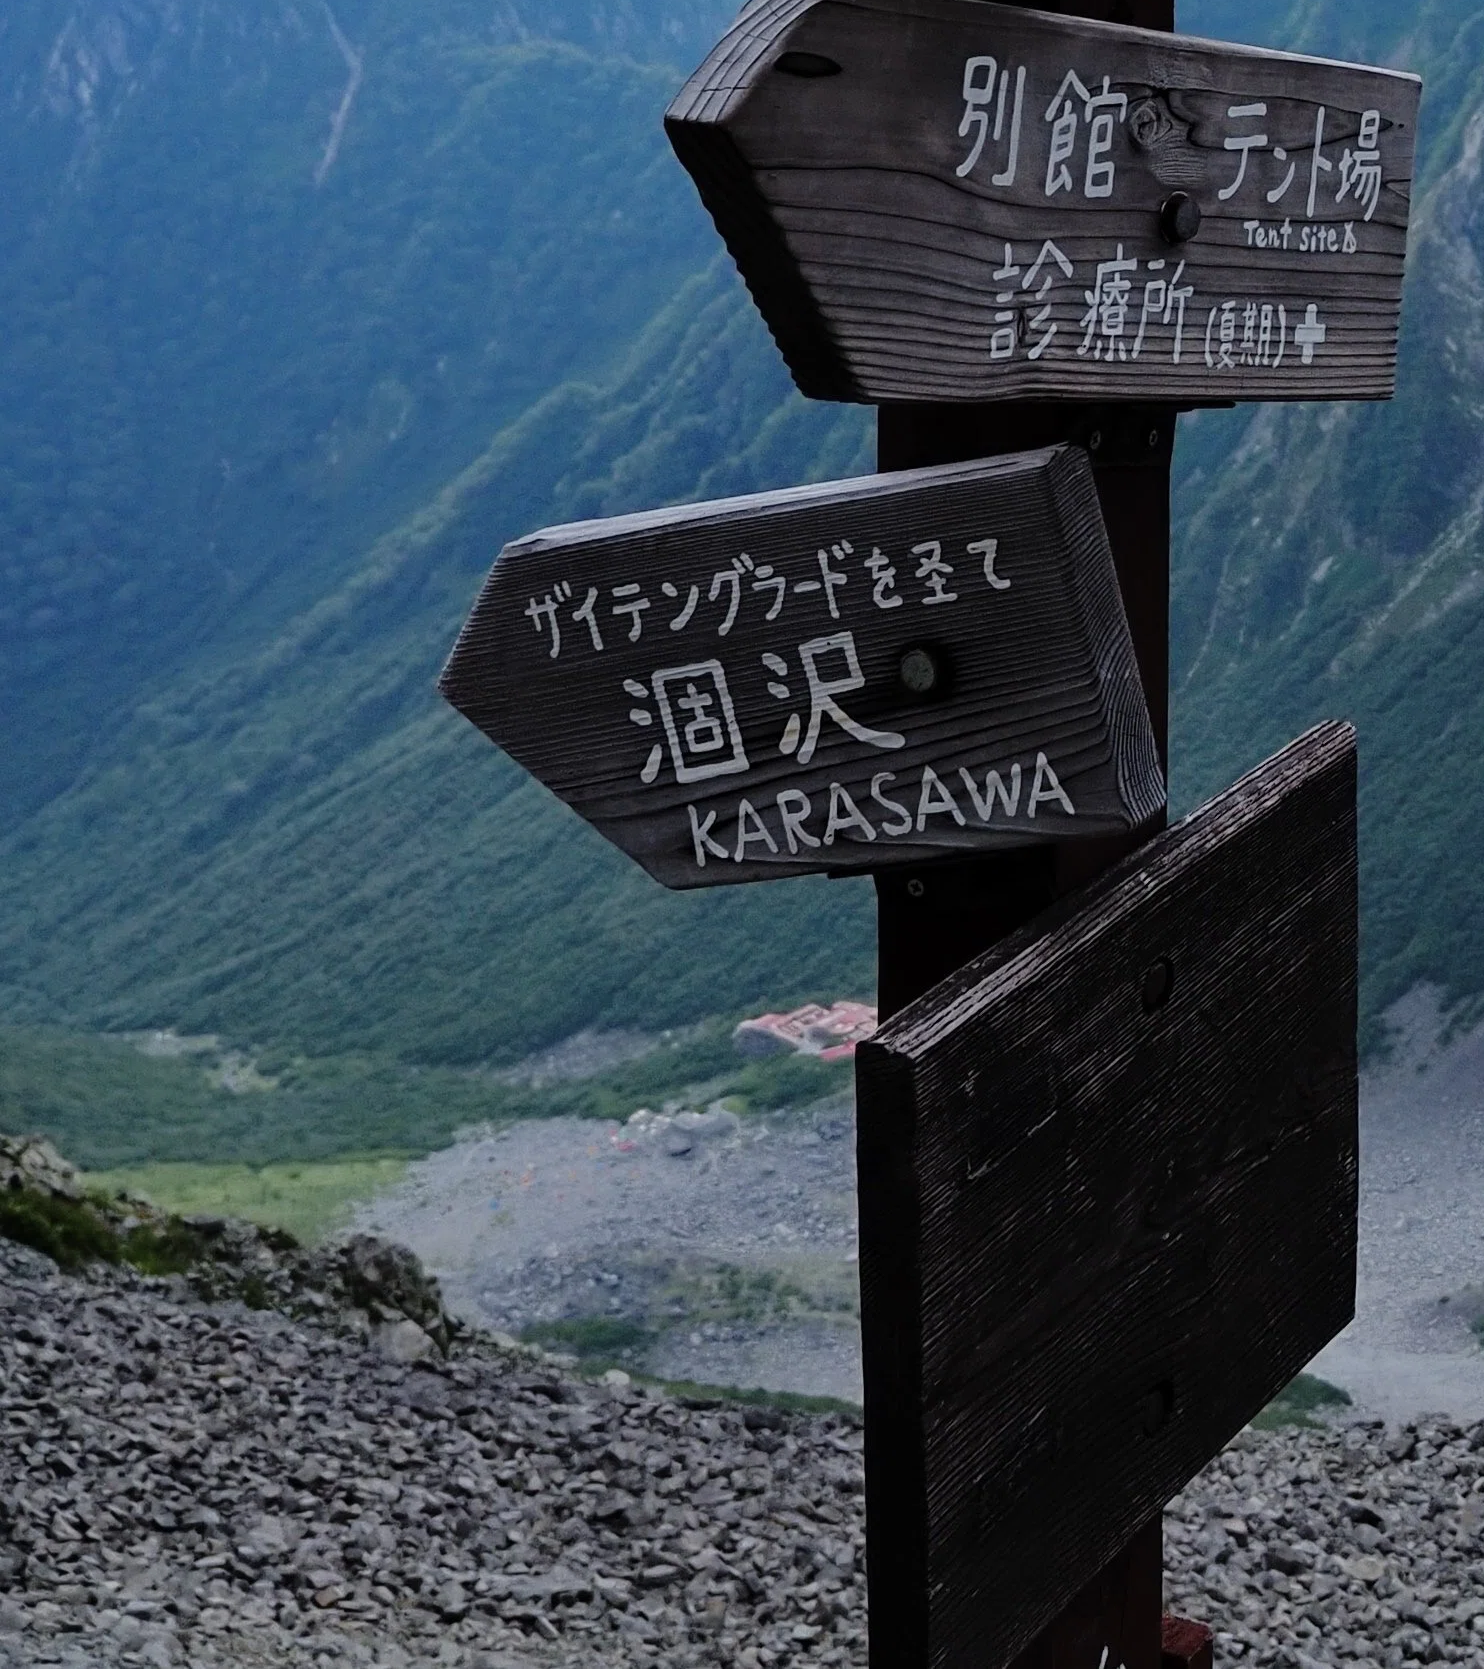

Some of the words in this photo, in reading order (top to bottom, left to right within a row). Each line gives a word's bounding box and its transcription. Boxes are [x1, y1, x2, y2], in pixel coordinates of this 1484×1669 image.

[956, 55, 1127, 198] 別館
[1218, 102, 1384, 222] テント場
[1243, 217, 1293, 250] Tent
[621, 631, 906, 785] 涸沢
[687, 752, 1075, 867] KARASAWA
